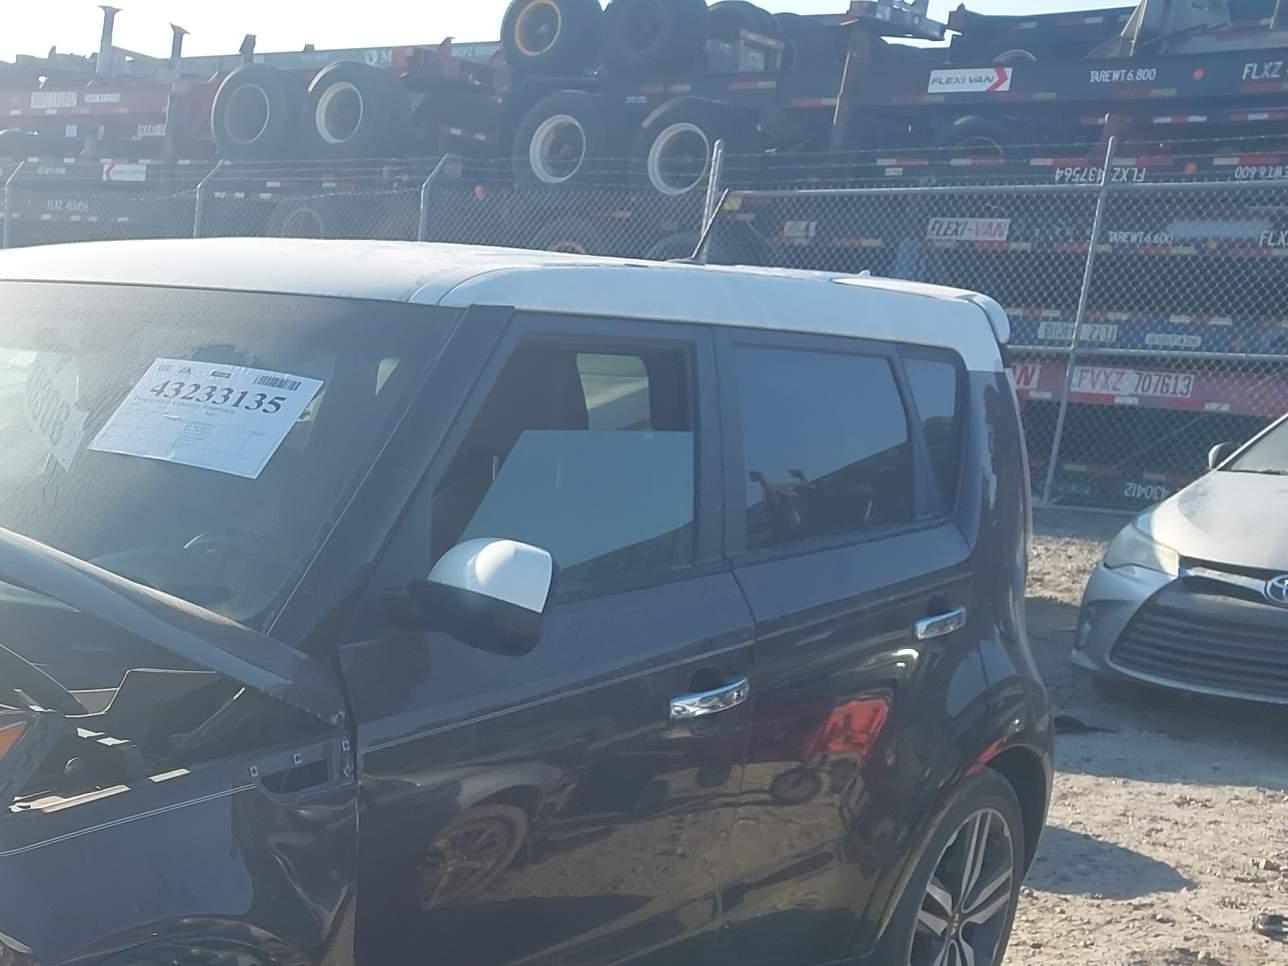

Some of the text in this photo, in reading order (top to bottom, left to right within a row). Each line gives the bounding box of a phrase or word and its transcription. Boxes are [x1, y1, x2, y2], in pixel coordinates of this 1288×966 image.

[1242, 61, 1284, 80] FLXZ
[1111, 167, 1146, 182] FLXZ
[1259, 230, 1288, 246] FLX
[1134, 371, 1193, 396] 707613
[150, 380, 287, 414] 43233135
